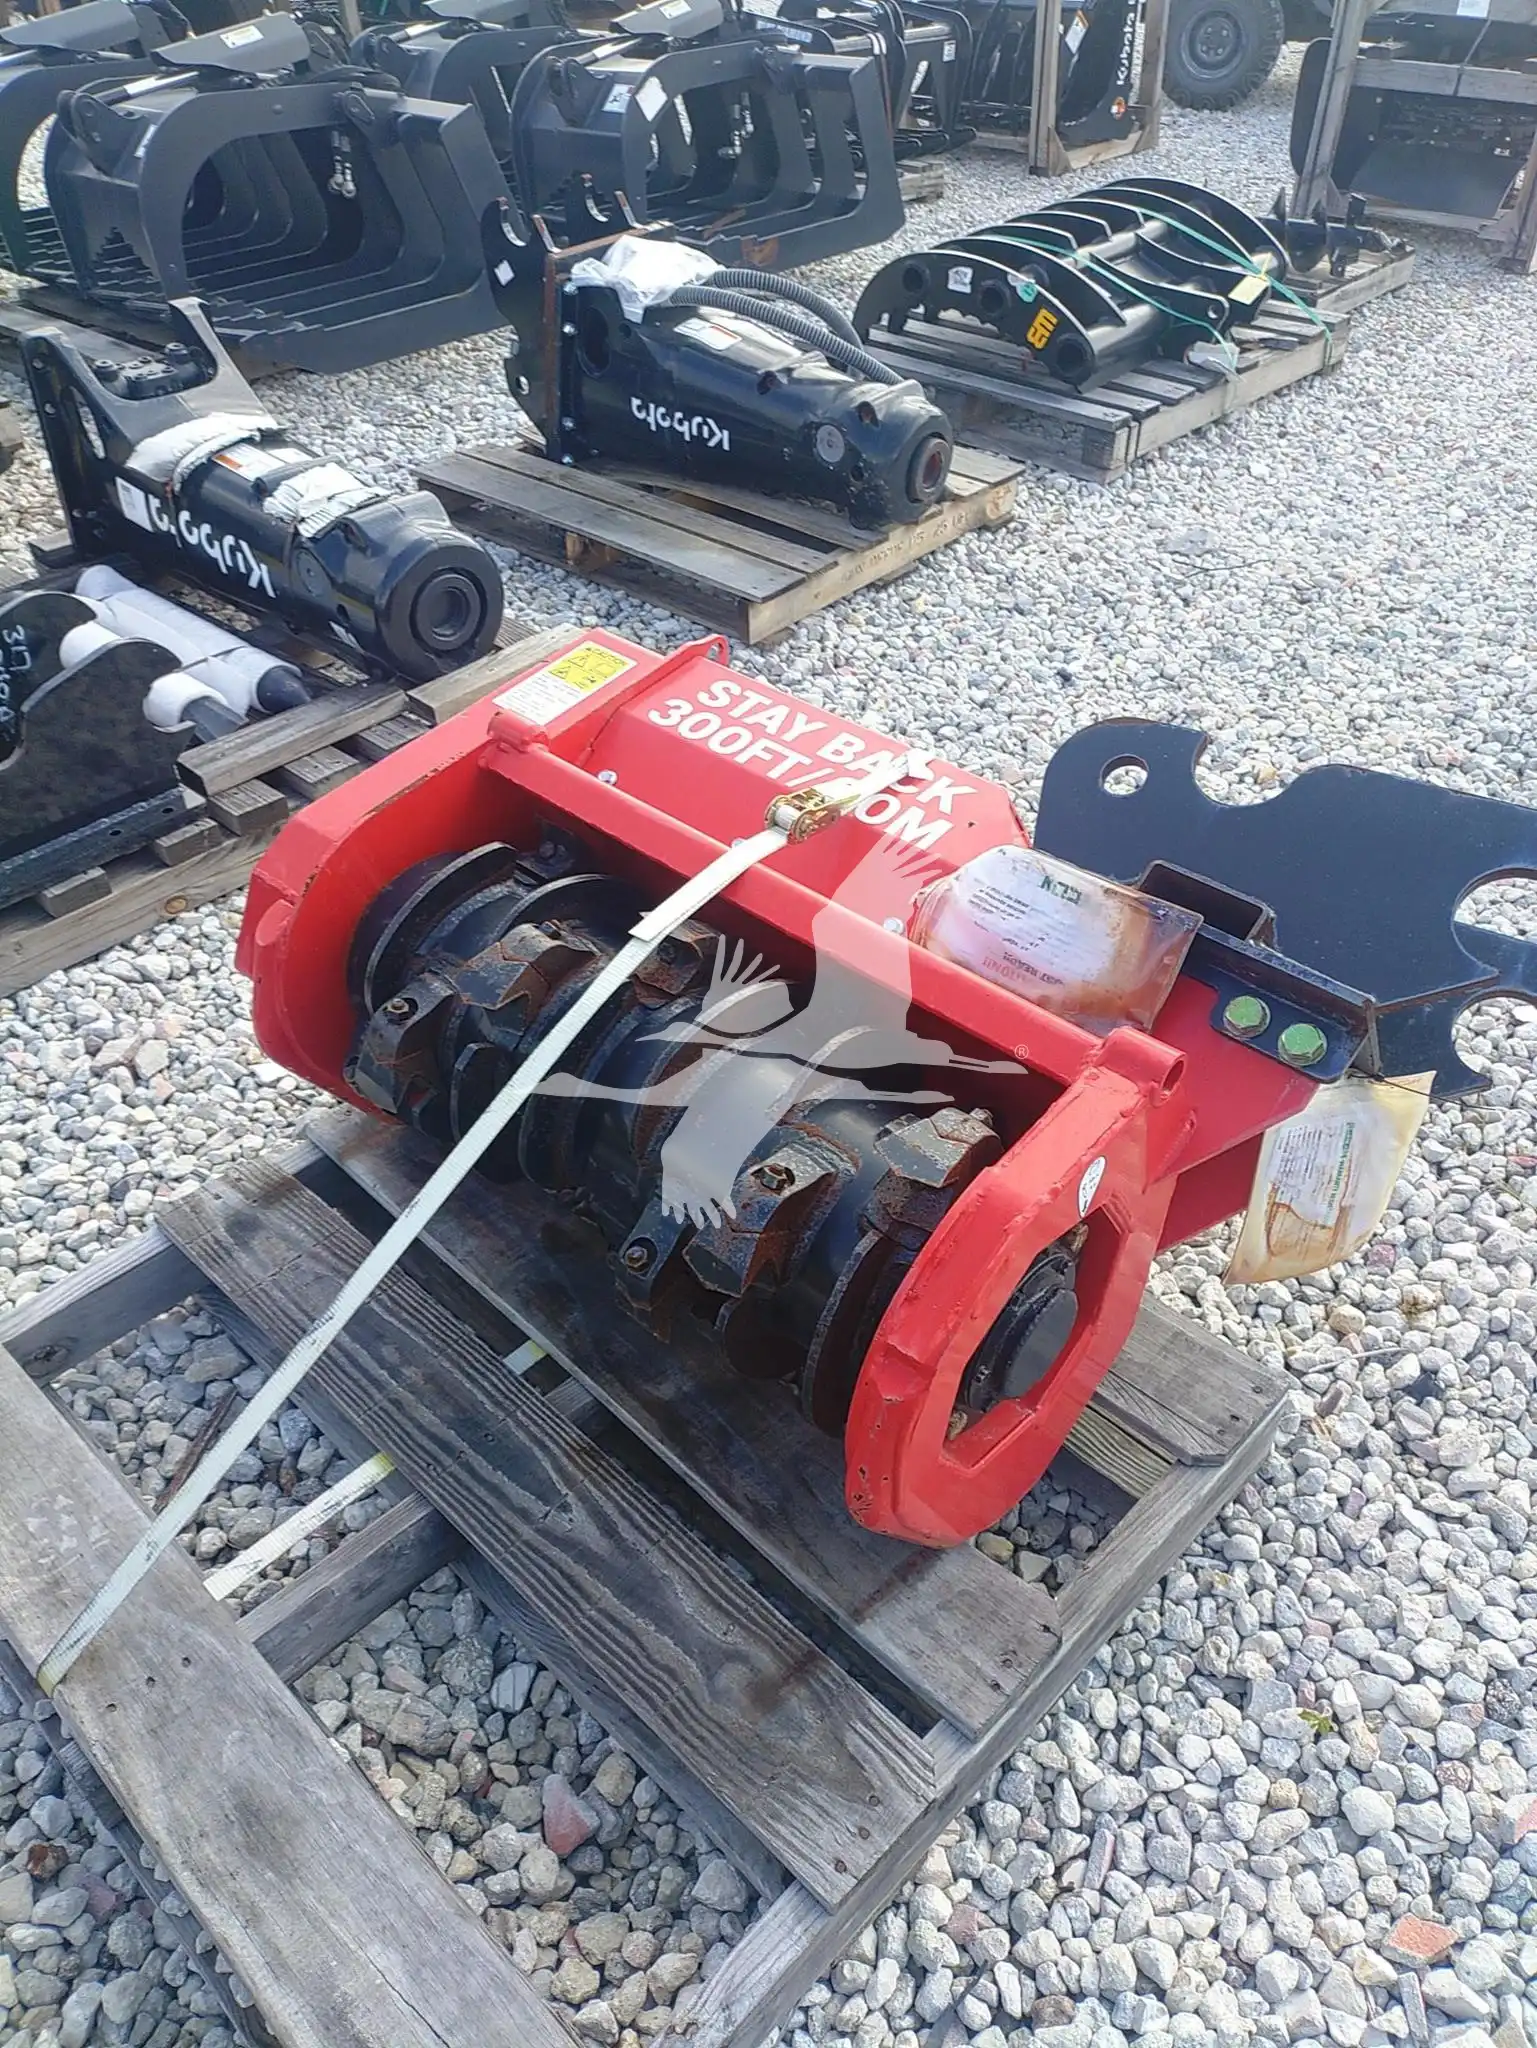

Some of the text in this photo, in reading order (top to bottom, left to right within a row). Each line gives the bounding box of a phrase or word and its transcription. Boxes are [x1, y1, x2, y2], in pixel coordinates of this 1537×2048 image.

[1116, 12, 1135, 85] Kubota
[630, 396, 730, 451] Kubota
[697, 680, 828, 742] STAY
[647, 699, 953, 850] 300FT/0M
